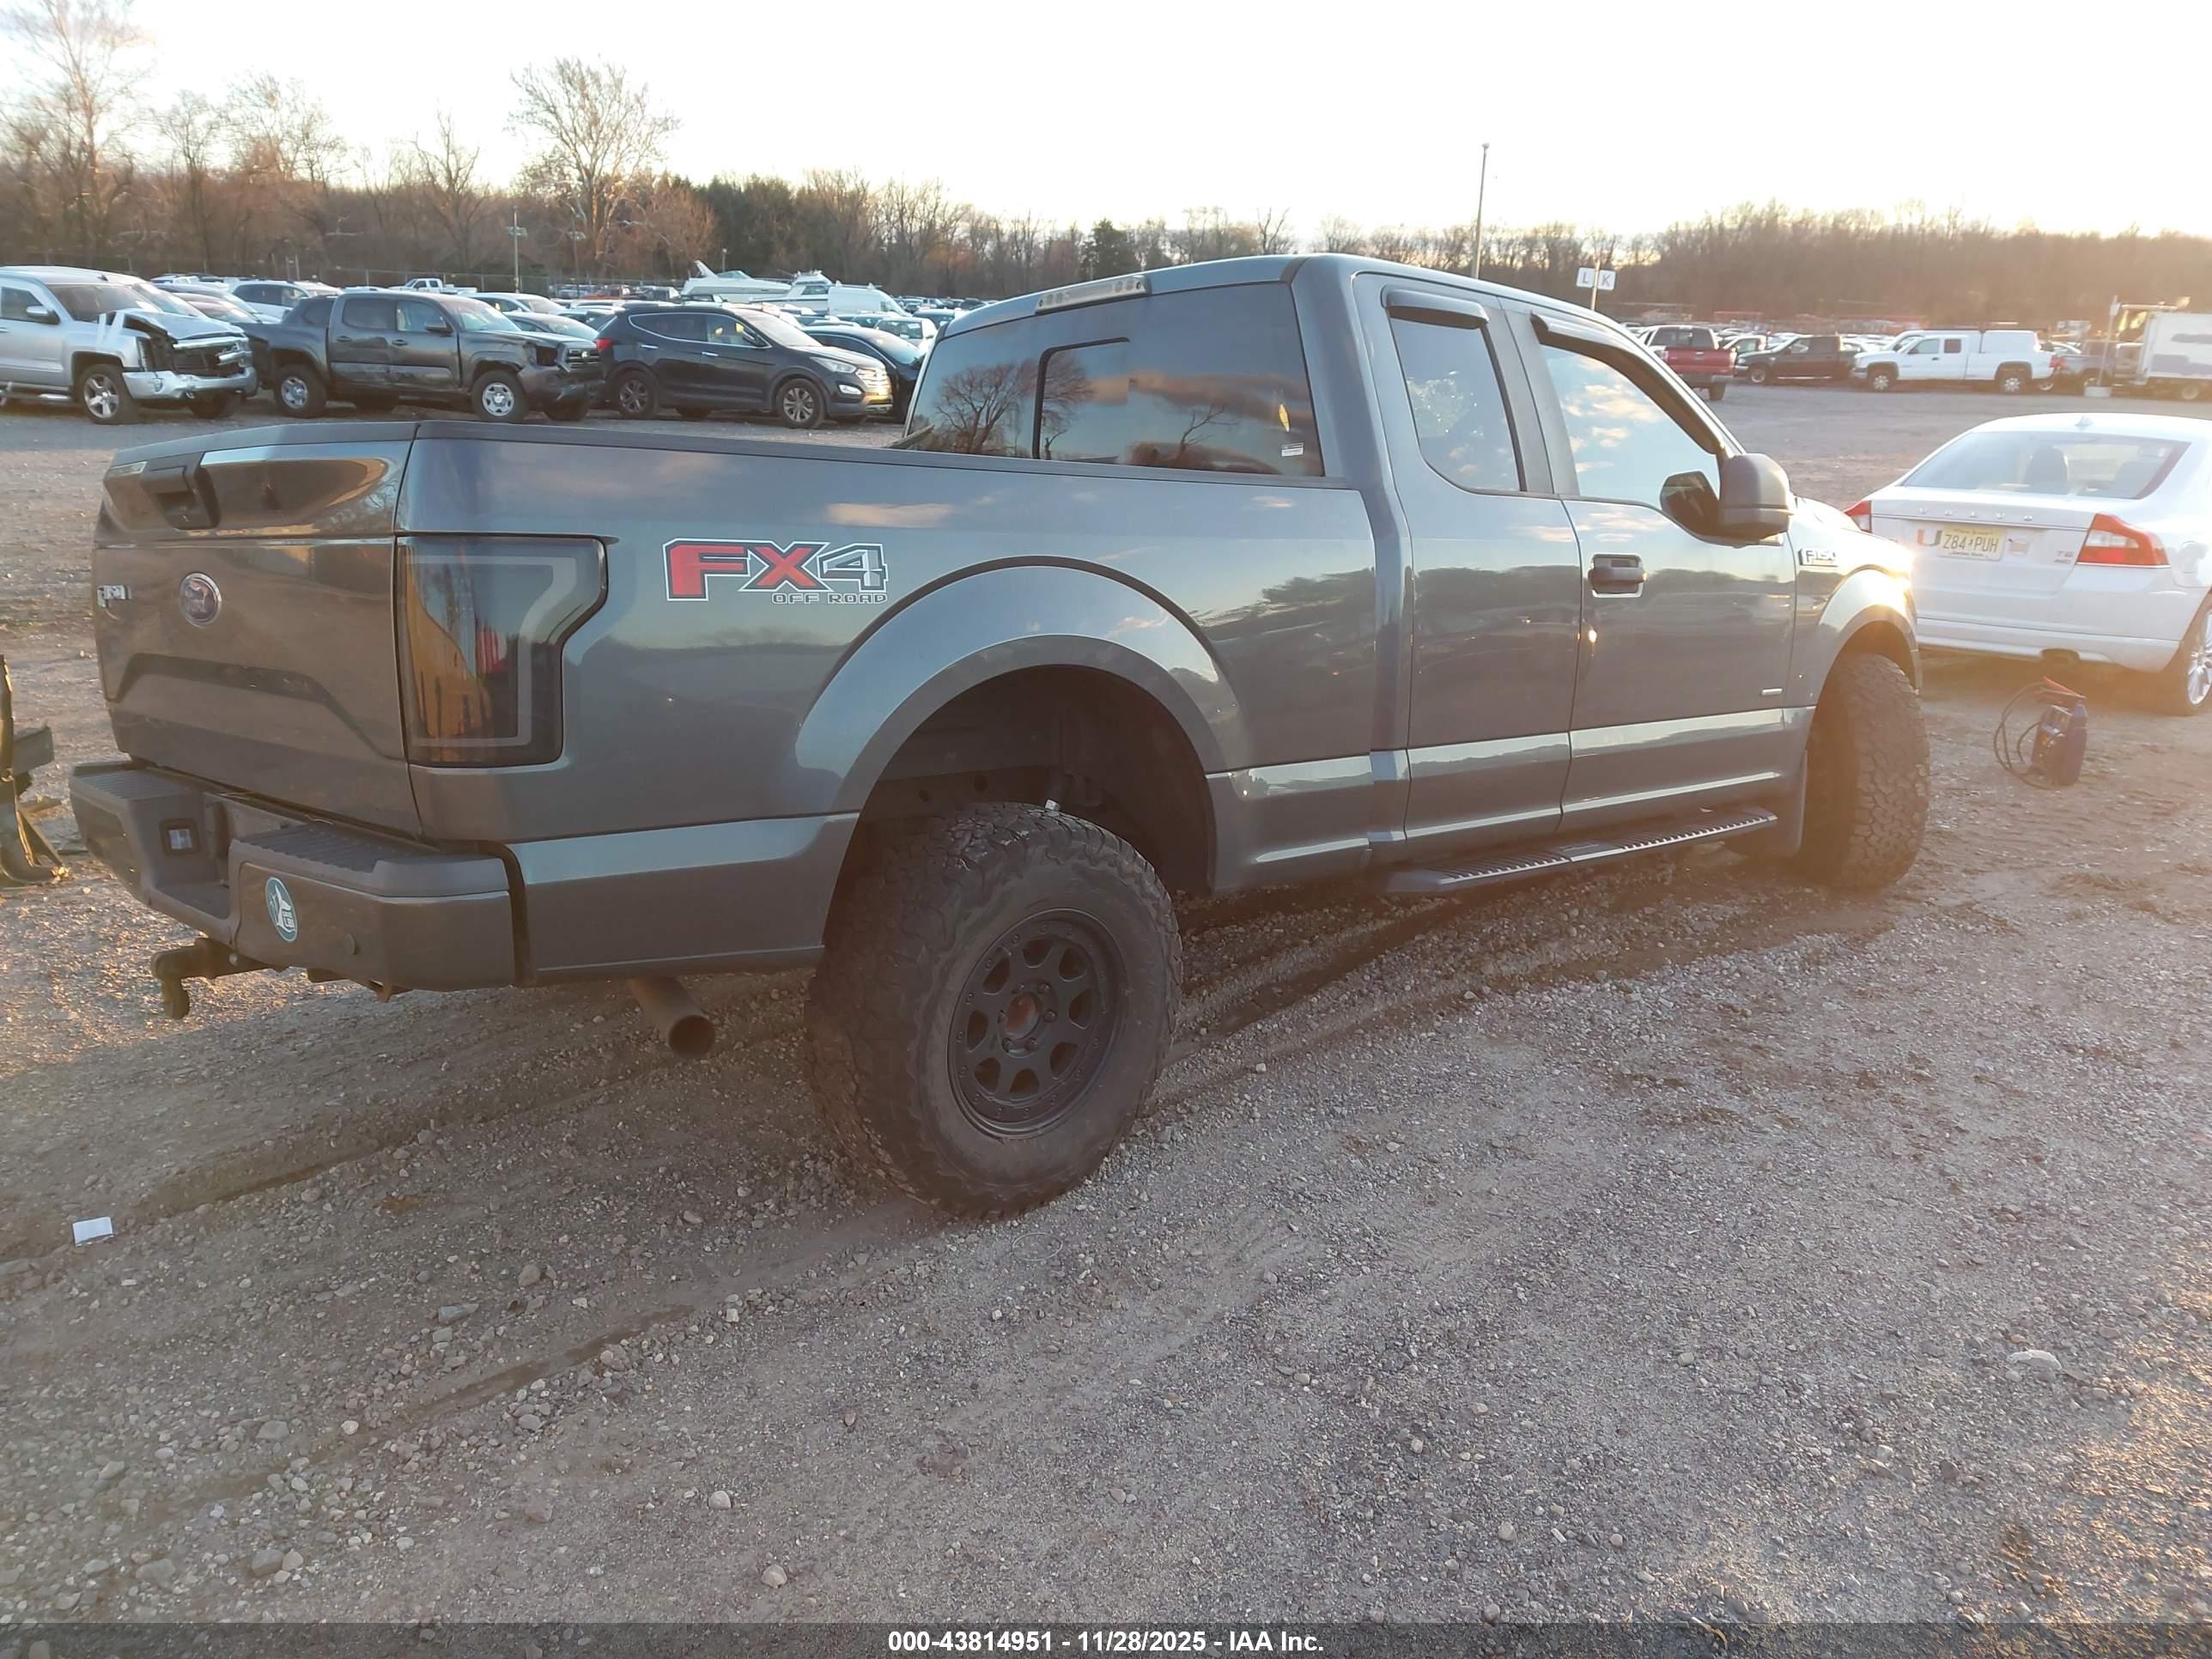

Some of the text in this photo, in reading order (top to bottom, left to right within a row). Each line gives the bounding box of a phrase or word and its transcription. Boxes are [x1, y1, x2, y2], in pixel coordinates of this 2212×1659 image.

[1582, 271, 1589, 283] L
[1601, 274, 1611, 287] K
[662, 538, 889, 601] FX4
[771, 592, 888, 605] OFF ROAD
